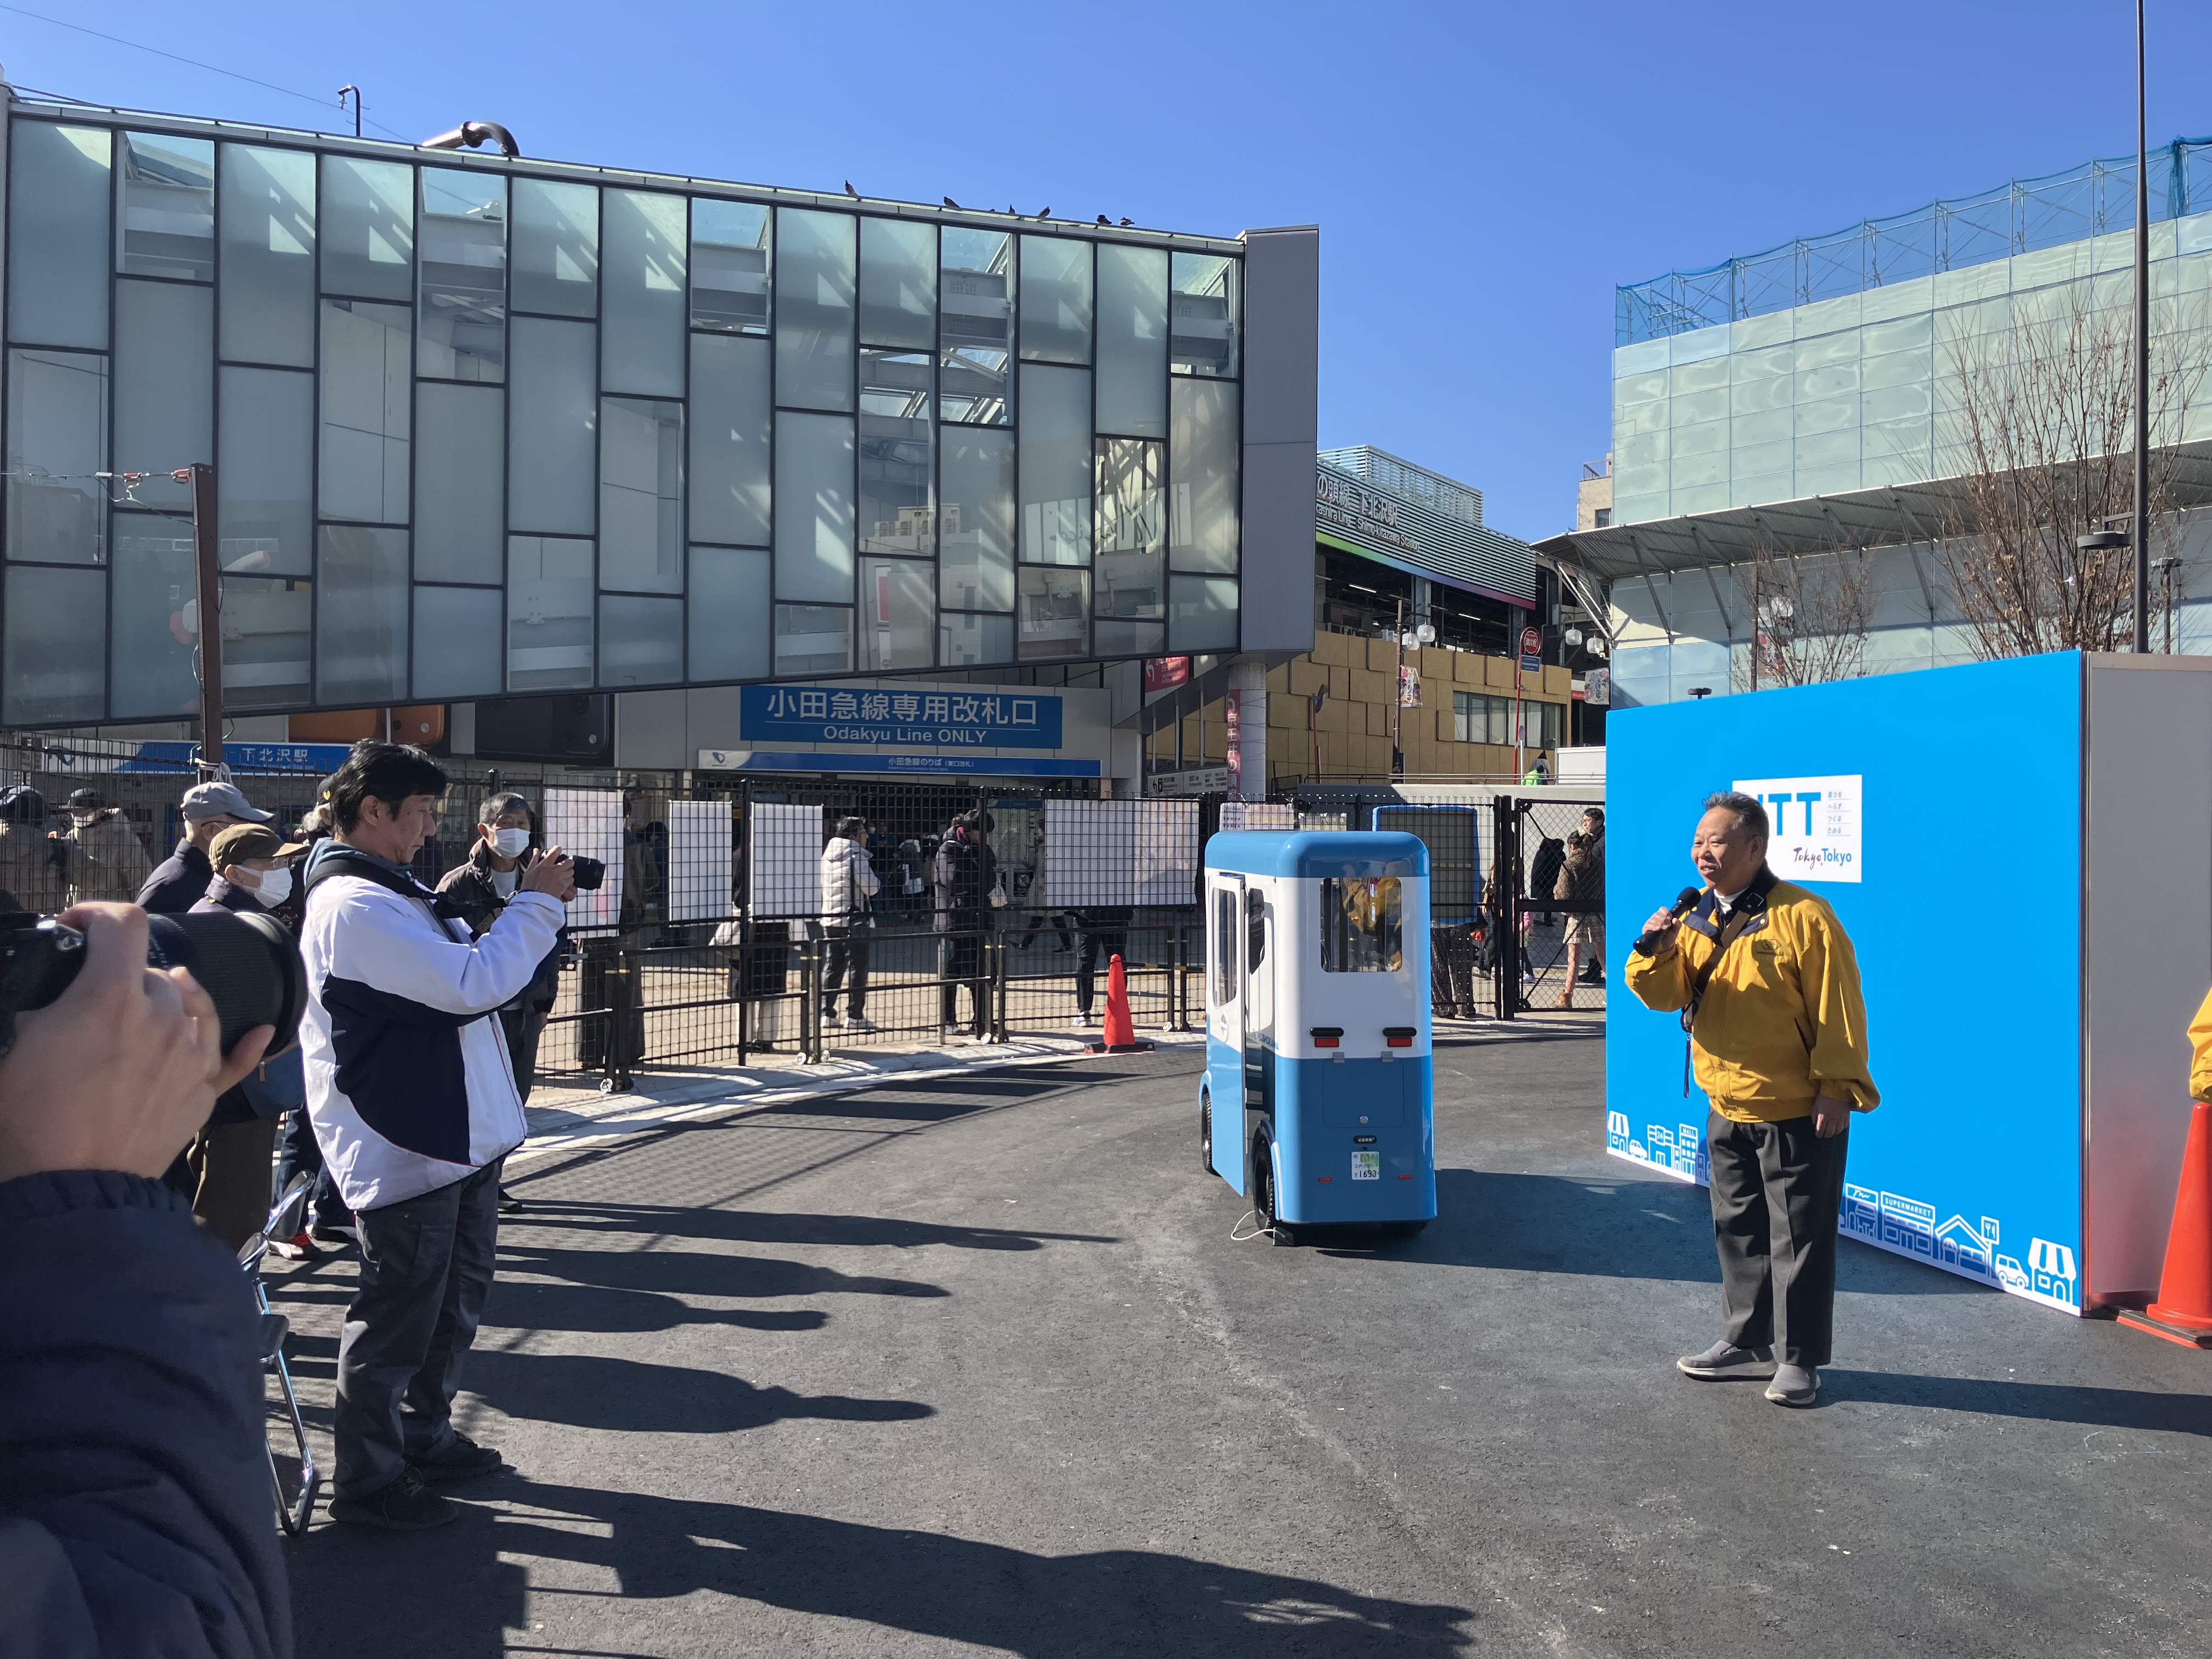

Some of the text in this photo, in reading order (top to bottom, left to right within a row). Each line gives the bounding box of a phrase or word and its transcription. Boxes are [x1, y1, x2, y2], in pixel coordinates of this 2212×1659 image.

[1358, 489, 1398, 527] 下北沢駅
[1401, 534, 1420, 550] Station
[768, 690, 1036, 725] 小田急線専用改札口
[823, 726, 986, 743] Odakyu Line ONLY
[241, 748, 308, 762] 下北沢駅
[888, 758, 943, 766] 小田急線のりば
[1758, 792, 1821, 836] TT
[1657, 1131, 1663, 1139] 24
[1683, 1128, 1695, 1136] MALL
[1885, 1198, 1931, 1217] SUPERMARKET
